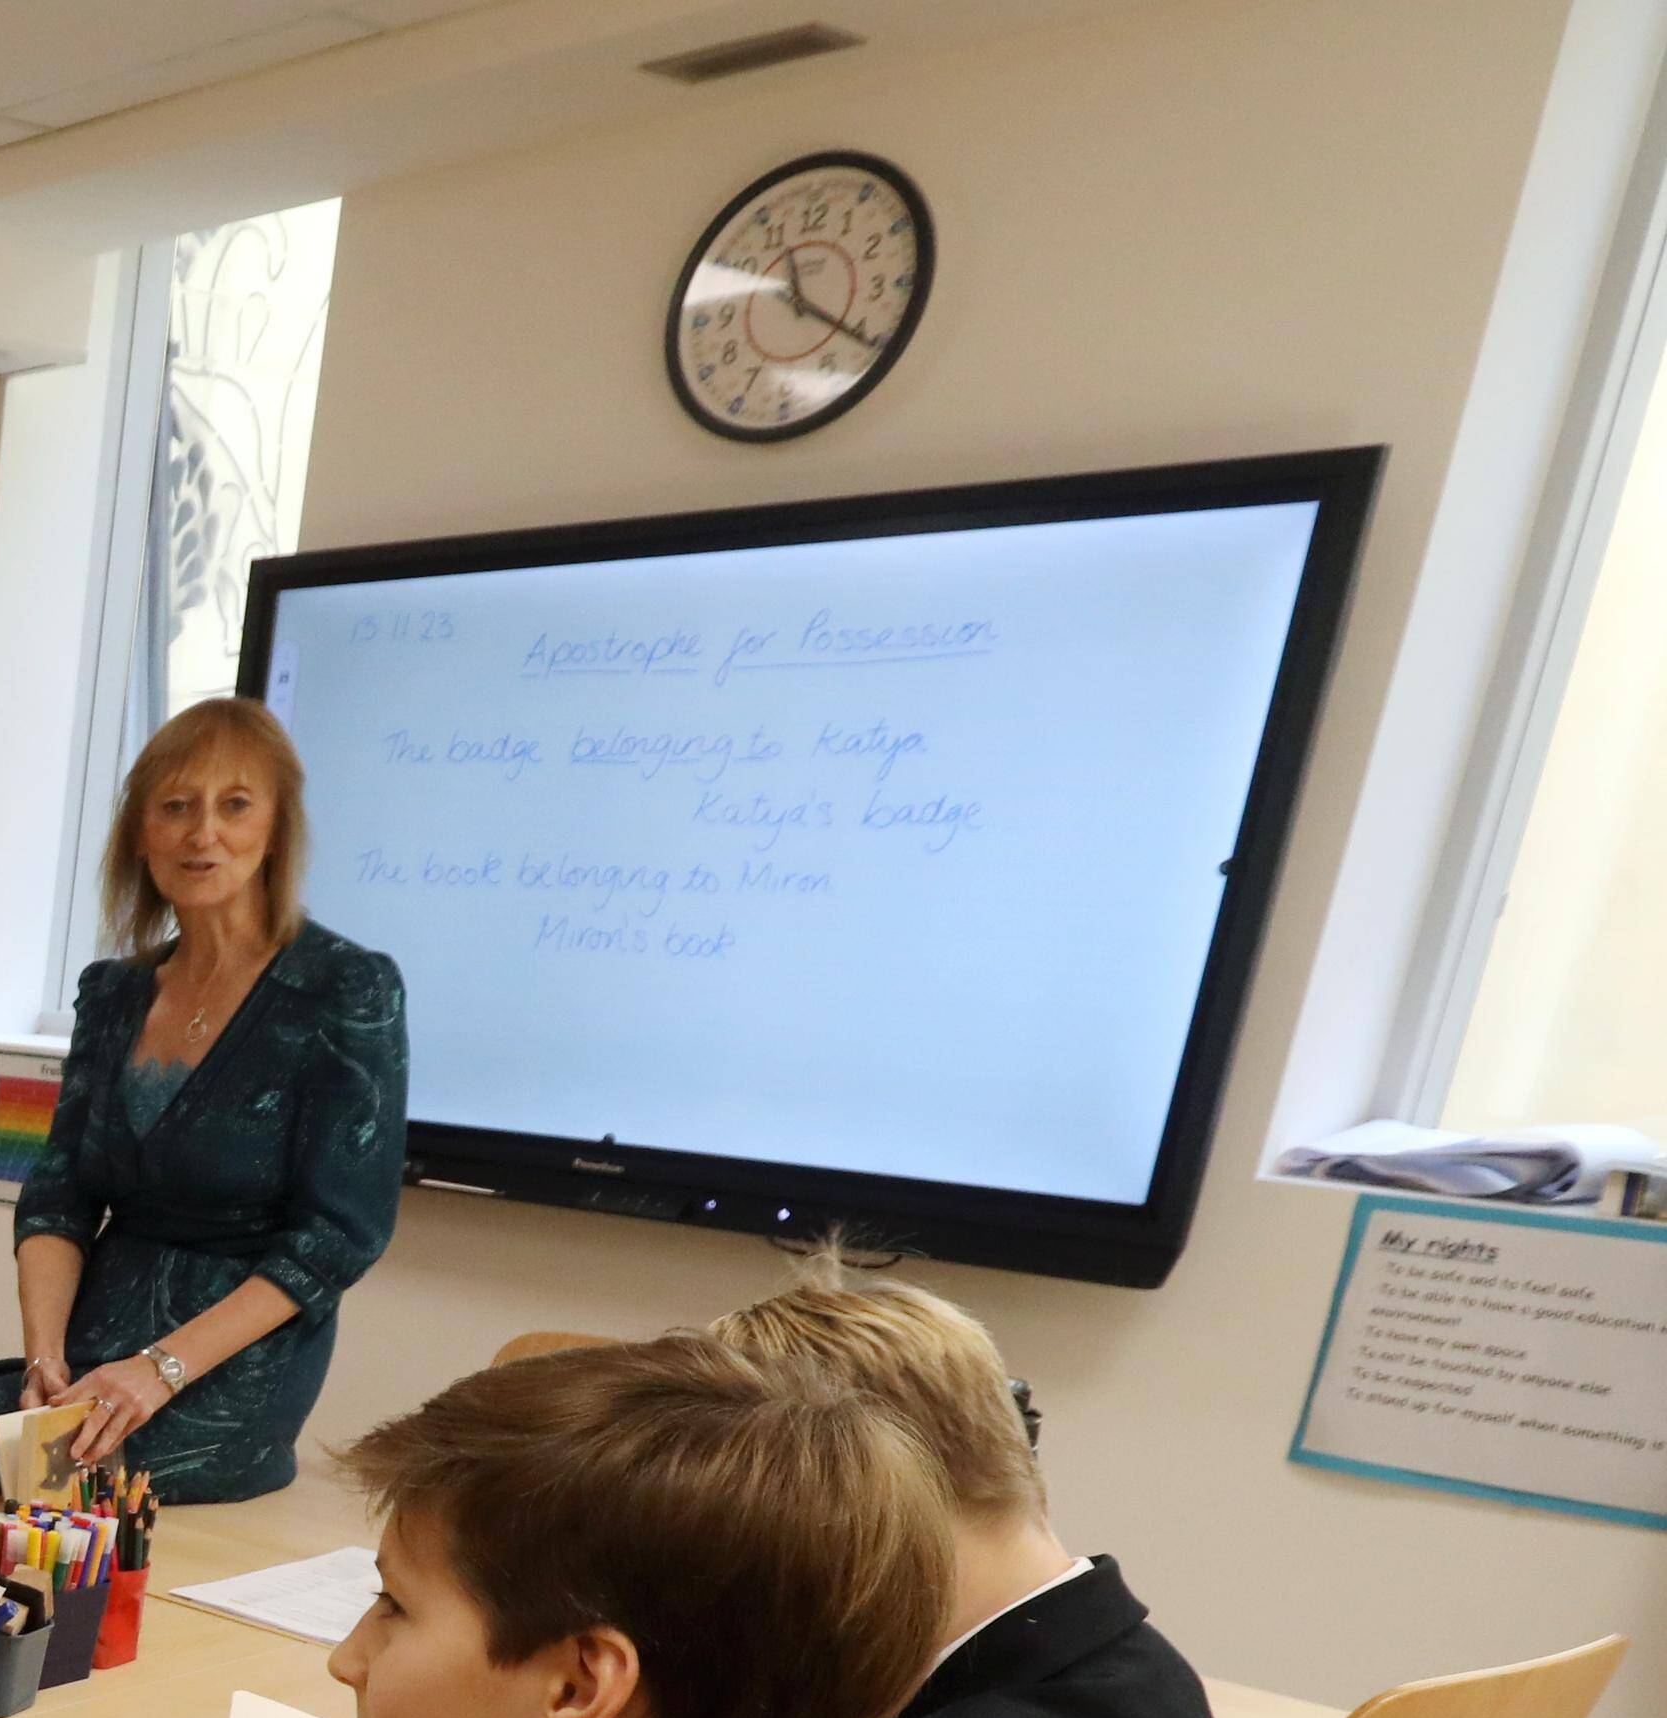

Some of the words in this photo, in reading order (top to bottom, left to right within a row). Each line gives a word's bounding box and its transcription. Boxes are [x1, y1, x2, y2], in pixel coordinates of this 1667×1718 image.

[799, 203, 829, 234] 12
[841, 208, 853, 236] 1
[764, 223, 786, 250] 11
[863, 232, 883, 260] 2
[869, 273, 886, 303] 3
[719, 302, 736, 330] 9
[721, 339, 739, 365] 8
[745, 364, 762, 393] 7
[522, 628, 702, 678] Apostrophe
[714, 626, 779, 688] for
[800, 607, 1000, 652] Possession
[383, 728, 434, 765] The
[445, 728, 545, 781] badge
[570, 724, 733, 783] belonging
[745, 723, 784, 758] to
[692, 790, 835, 852] Katya's
[861, 787, 985, 853] badge
[356, 848, 407, 886] The
[422, 851, 502, 889] book
[514, 852, 668, 918] belonging
[682, 859, 721, 894] to
[666, 919, 738, 960] book
[1380, 1229, 1419, 1253] My
[1425, 1236, 1501, 1263] rights
[1576, 1311, 1657, 1332] education
